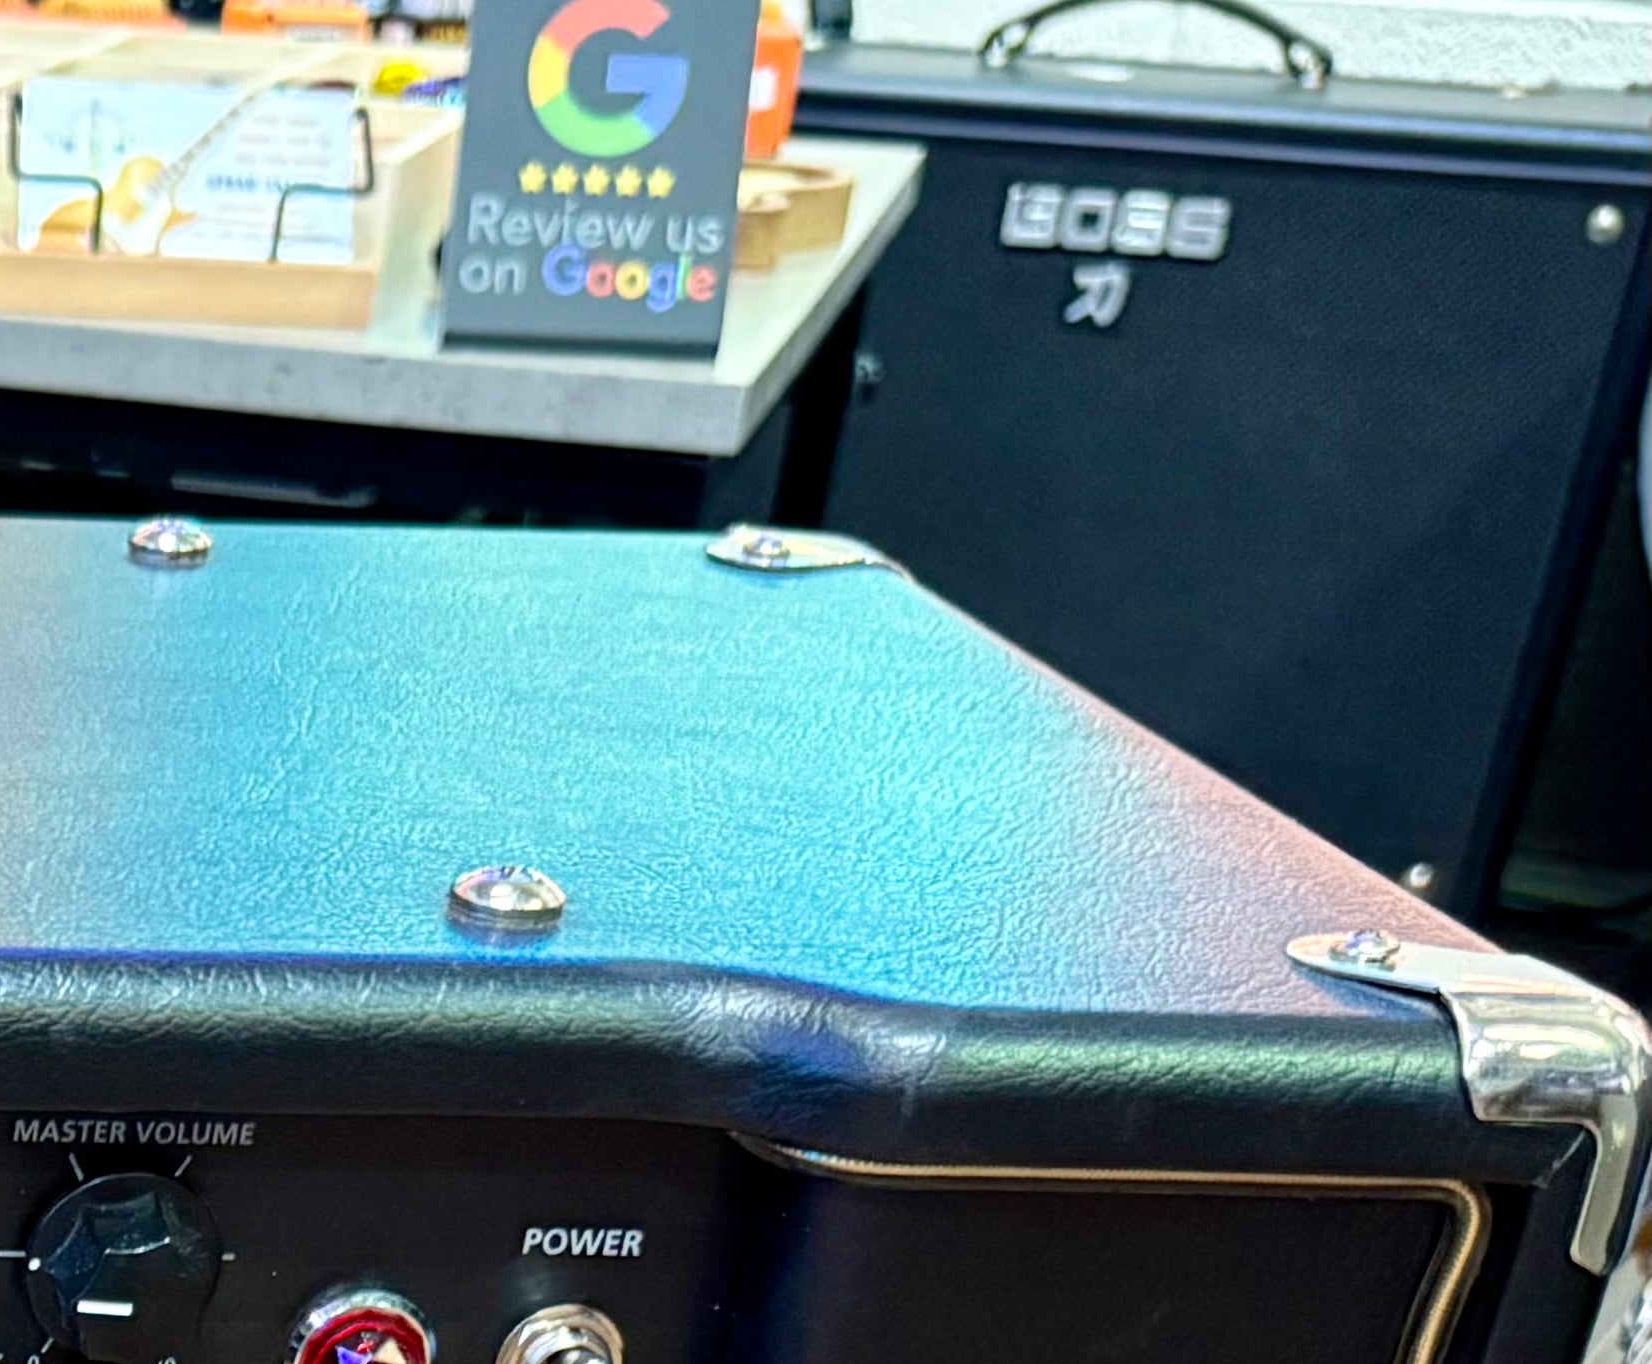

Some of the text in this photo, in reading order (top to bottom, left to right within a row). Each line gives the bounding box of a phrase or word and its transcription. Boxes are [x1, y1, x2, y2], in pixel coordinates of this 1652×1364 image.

[467, 193, 724, 254] Review us
[1000, 182, 1232, 260] BOSS
[458, 245, 717, 313] on Google
[13, 1119, 255, 1146] MASTER VOLUME
[522, 1227, 644, 1257] POWER
